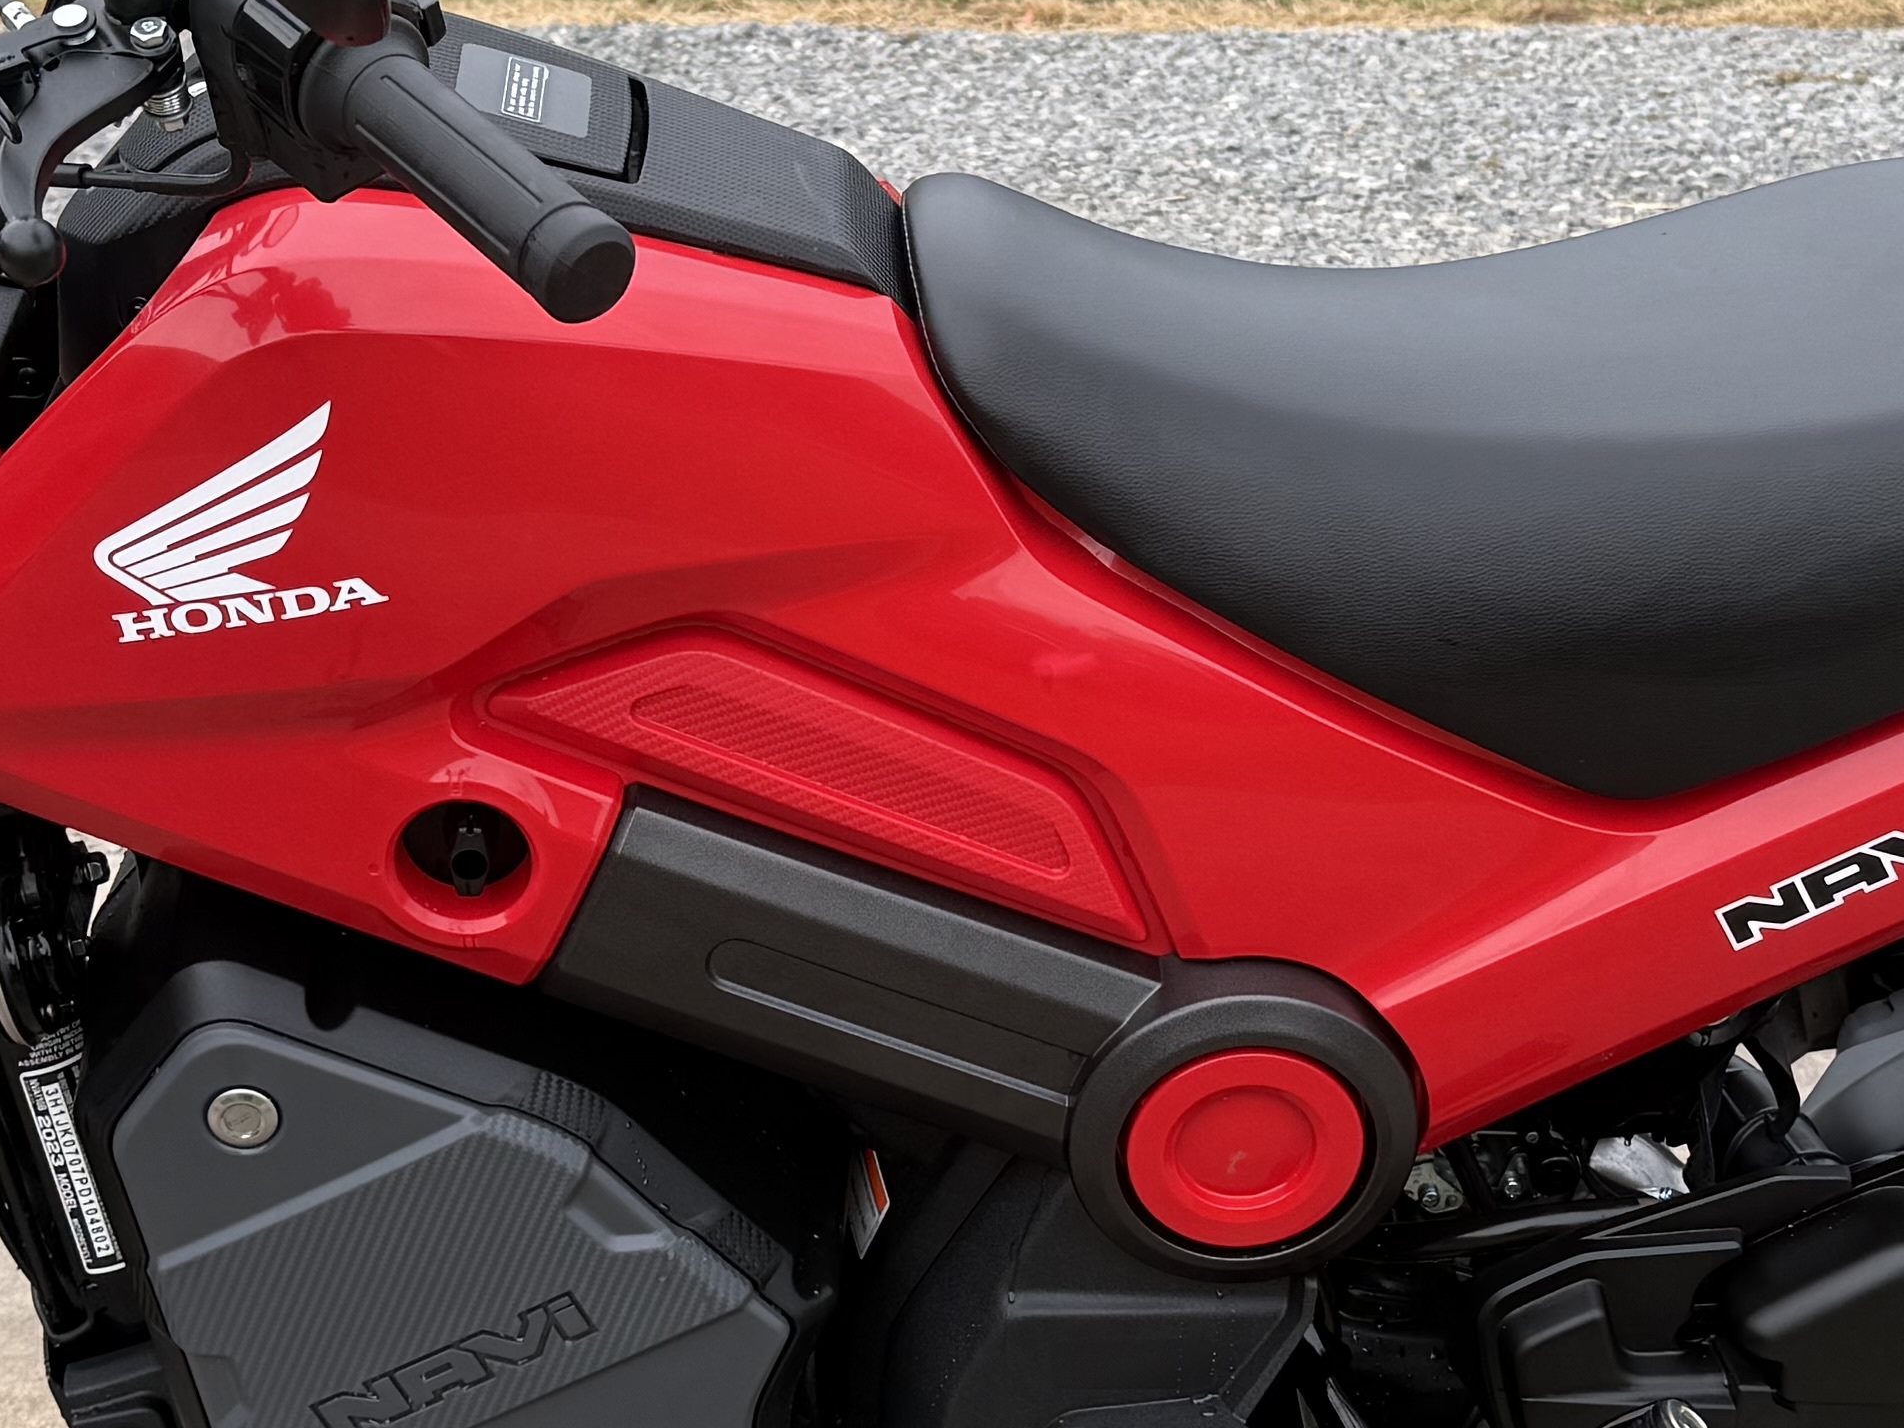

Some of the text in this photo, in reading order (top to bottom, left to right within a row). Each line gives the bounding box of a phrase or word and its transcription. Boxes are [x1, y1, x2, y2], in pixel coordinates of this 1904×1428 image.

[111, 576, 390, 643] HONDA
[37, 1115, 66, 1168] 2023
[45, 1086, 111, 1253] 3H1JK0707PD104802
